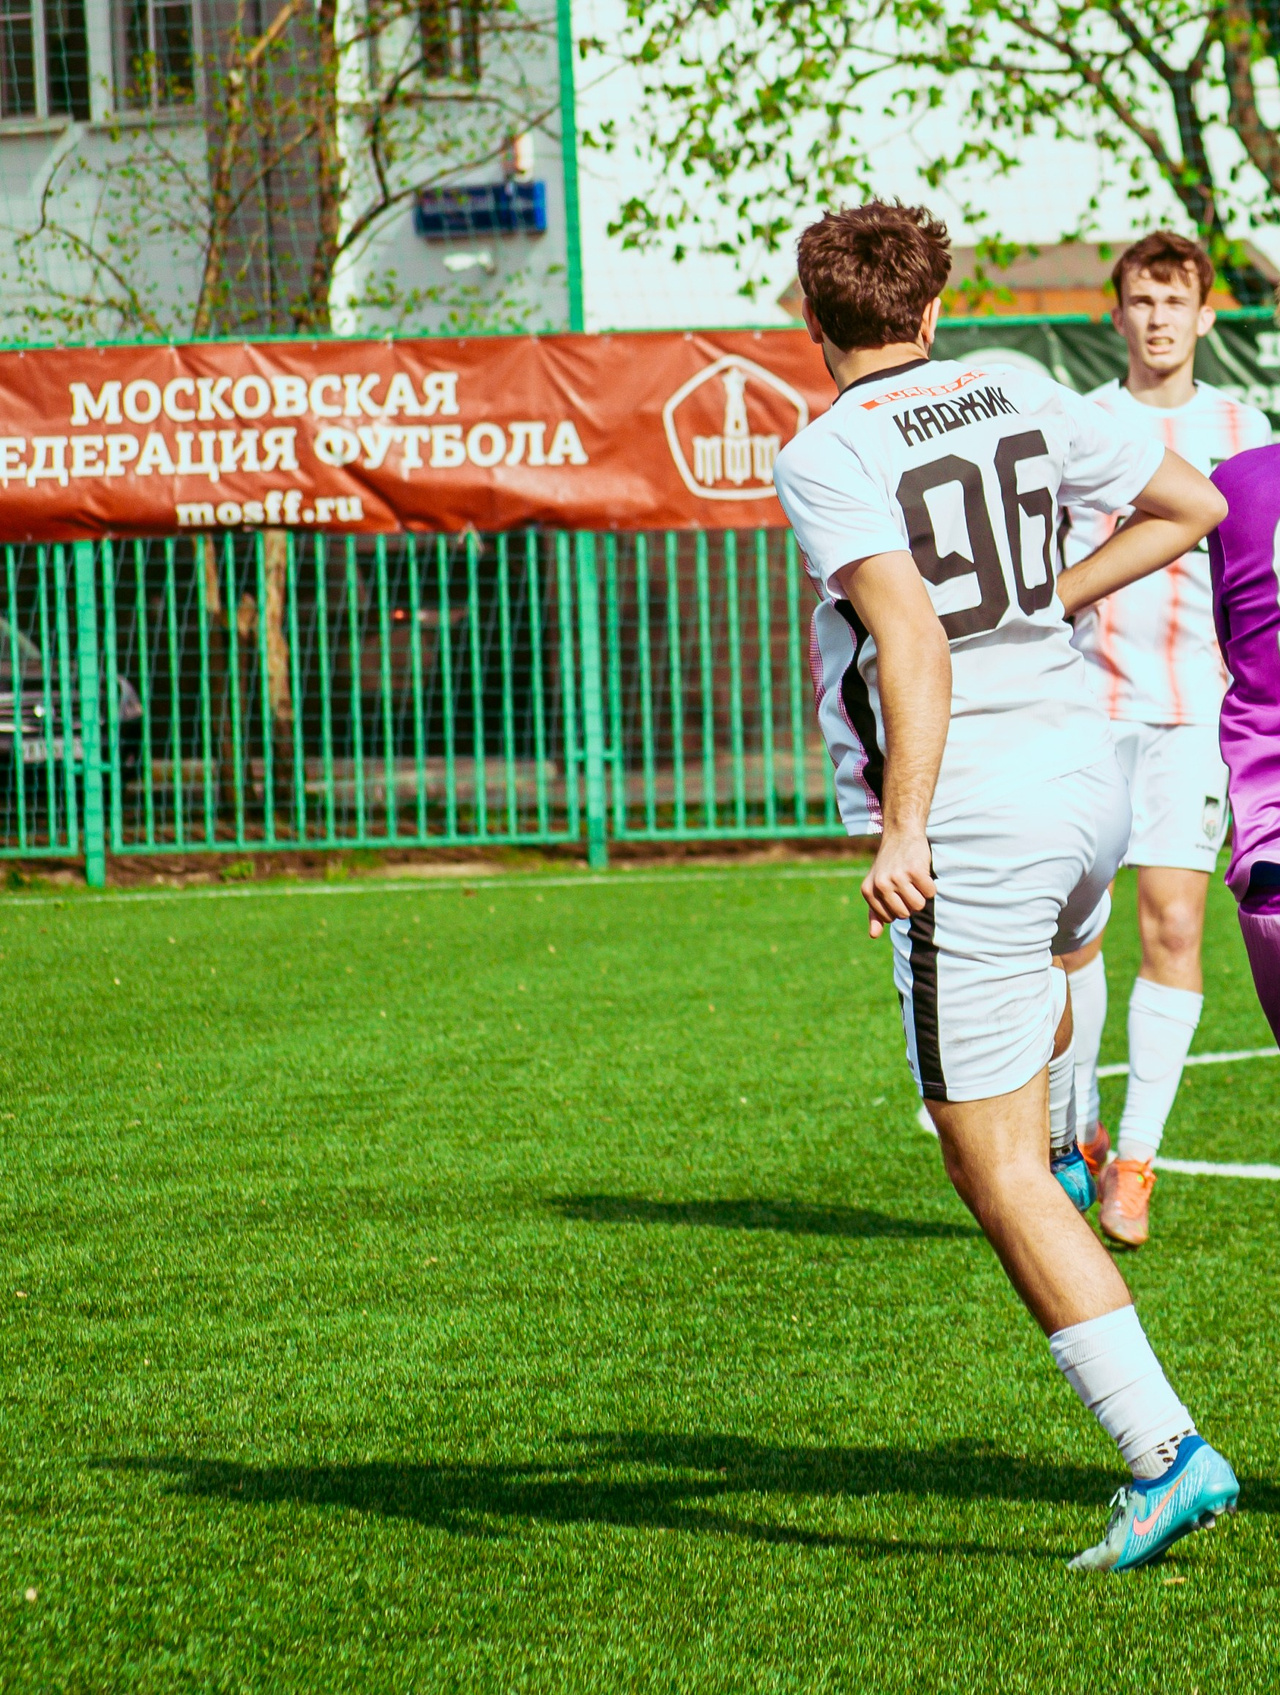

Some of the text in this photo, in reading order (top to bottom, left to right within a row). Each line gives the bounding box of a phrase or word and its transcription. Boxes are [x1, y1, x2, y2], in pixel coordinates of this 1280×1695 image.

[68, 371, 460, 427] МОСКОВСКАЯ
[892, 386, 1020, 448] КАДЖИК
[0, 420, 589, 488] ЕДЕРАЦИЯ ФУТБОЛА
[175, 489, 364, 527] mosff.ru
[895, 429, 1055, 641] 96
